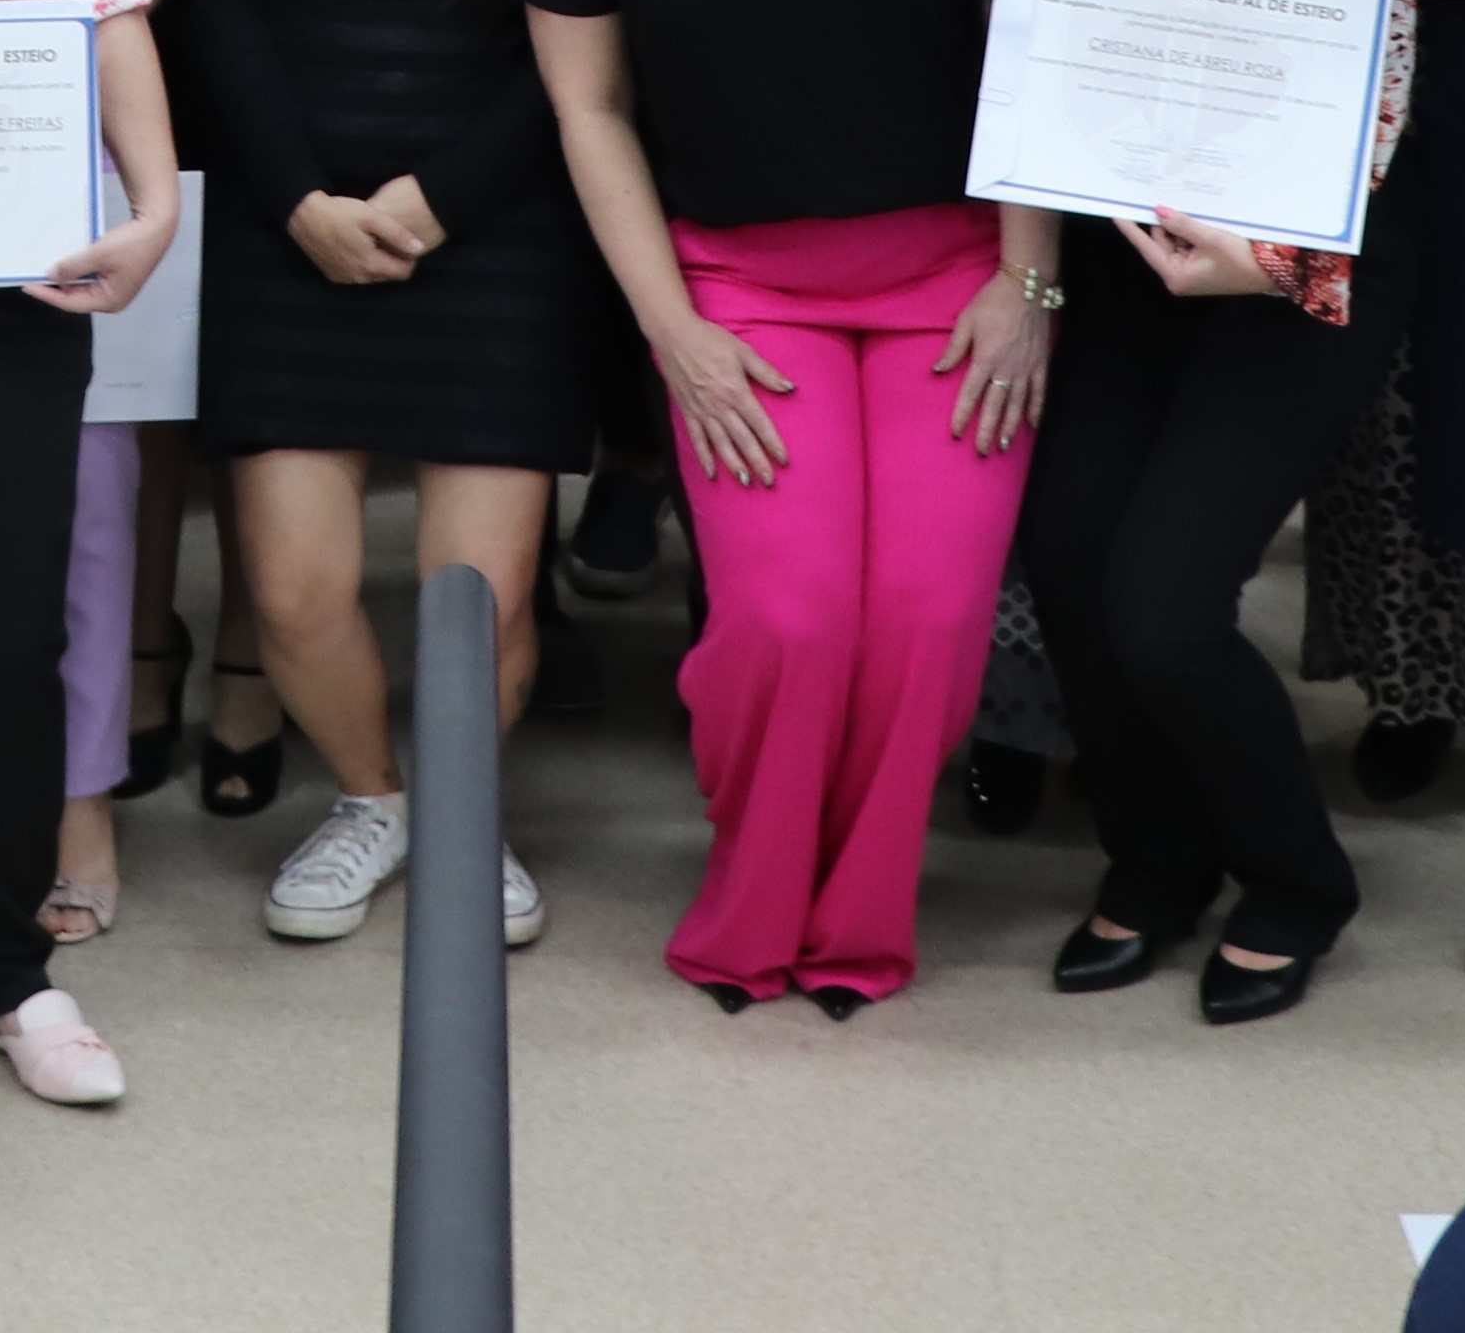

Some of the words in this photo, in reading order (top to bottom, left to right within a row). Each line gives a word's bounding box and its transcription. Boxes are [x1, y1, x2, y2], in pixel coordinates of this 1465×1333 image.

[1292, 1, 1346, 22] ESTEIO
[3, 48, 57, 64] ESTEIO
[1088, 36, 1164, 61] CRISTIANA
[1168, 49, 1189, 64] DE
[1192, 53, 1240, 73] ABREU
[1243, 62, 1285, 81] ROSA
[8, 116, 62, 130] FREITAS
